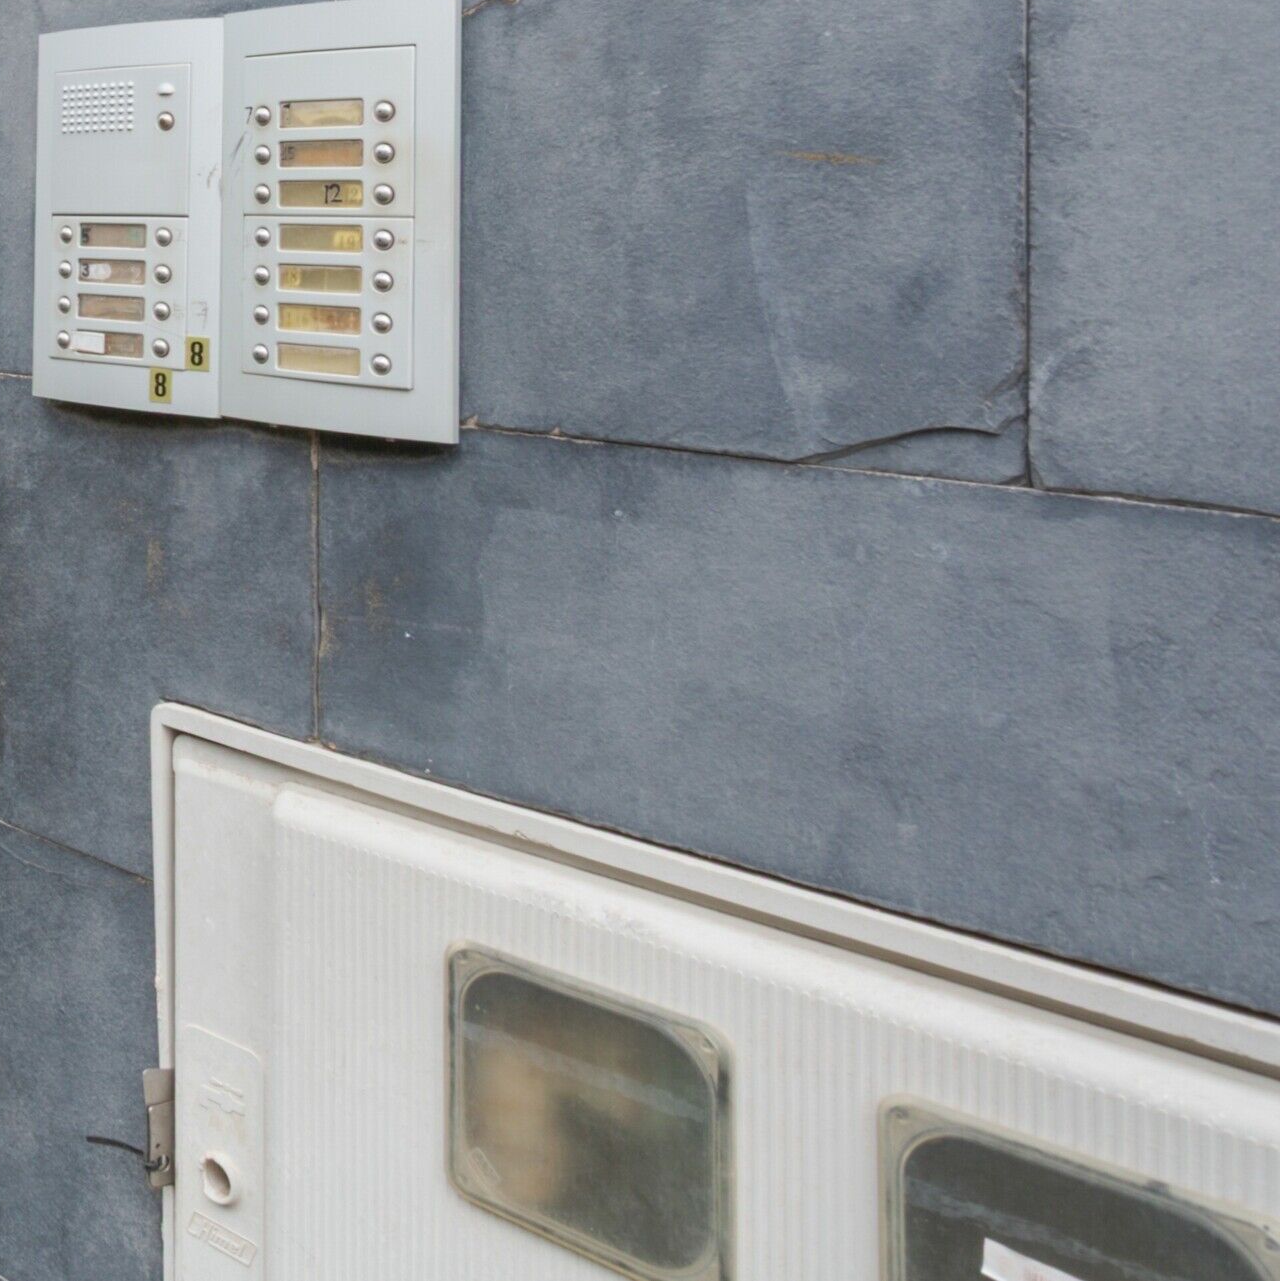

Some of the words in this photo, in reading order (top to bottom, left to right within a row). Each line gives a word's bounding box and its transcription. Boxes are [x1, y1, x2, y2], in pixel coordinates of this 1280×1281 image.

[324, 183, 343, 204] 12
[81, 228, 91, 244] 5
[81, 263, 90, 277] 3
[191, 341, 203, 366] 8
[154, 372, 167, 397] 8
